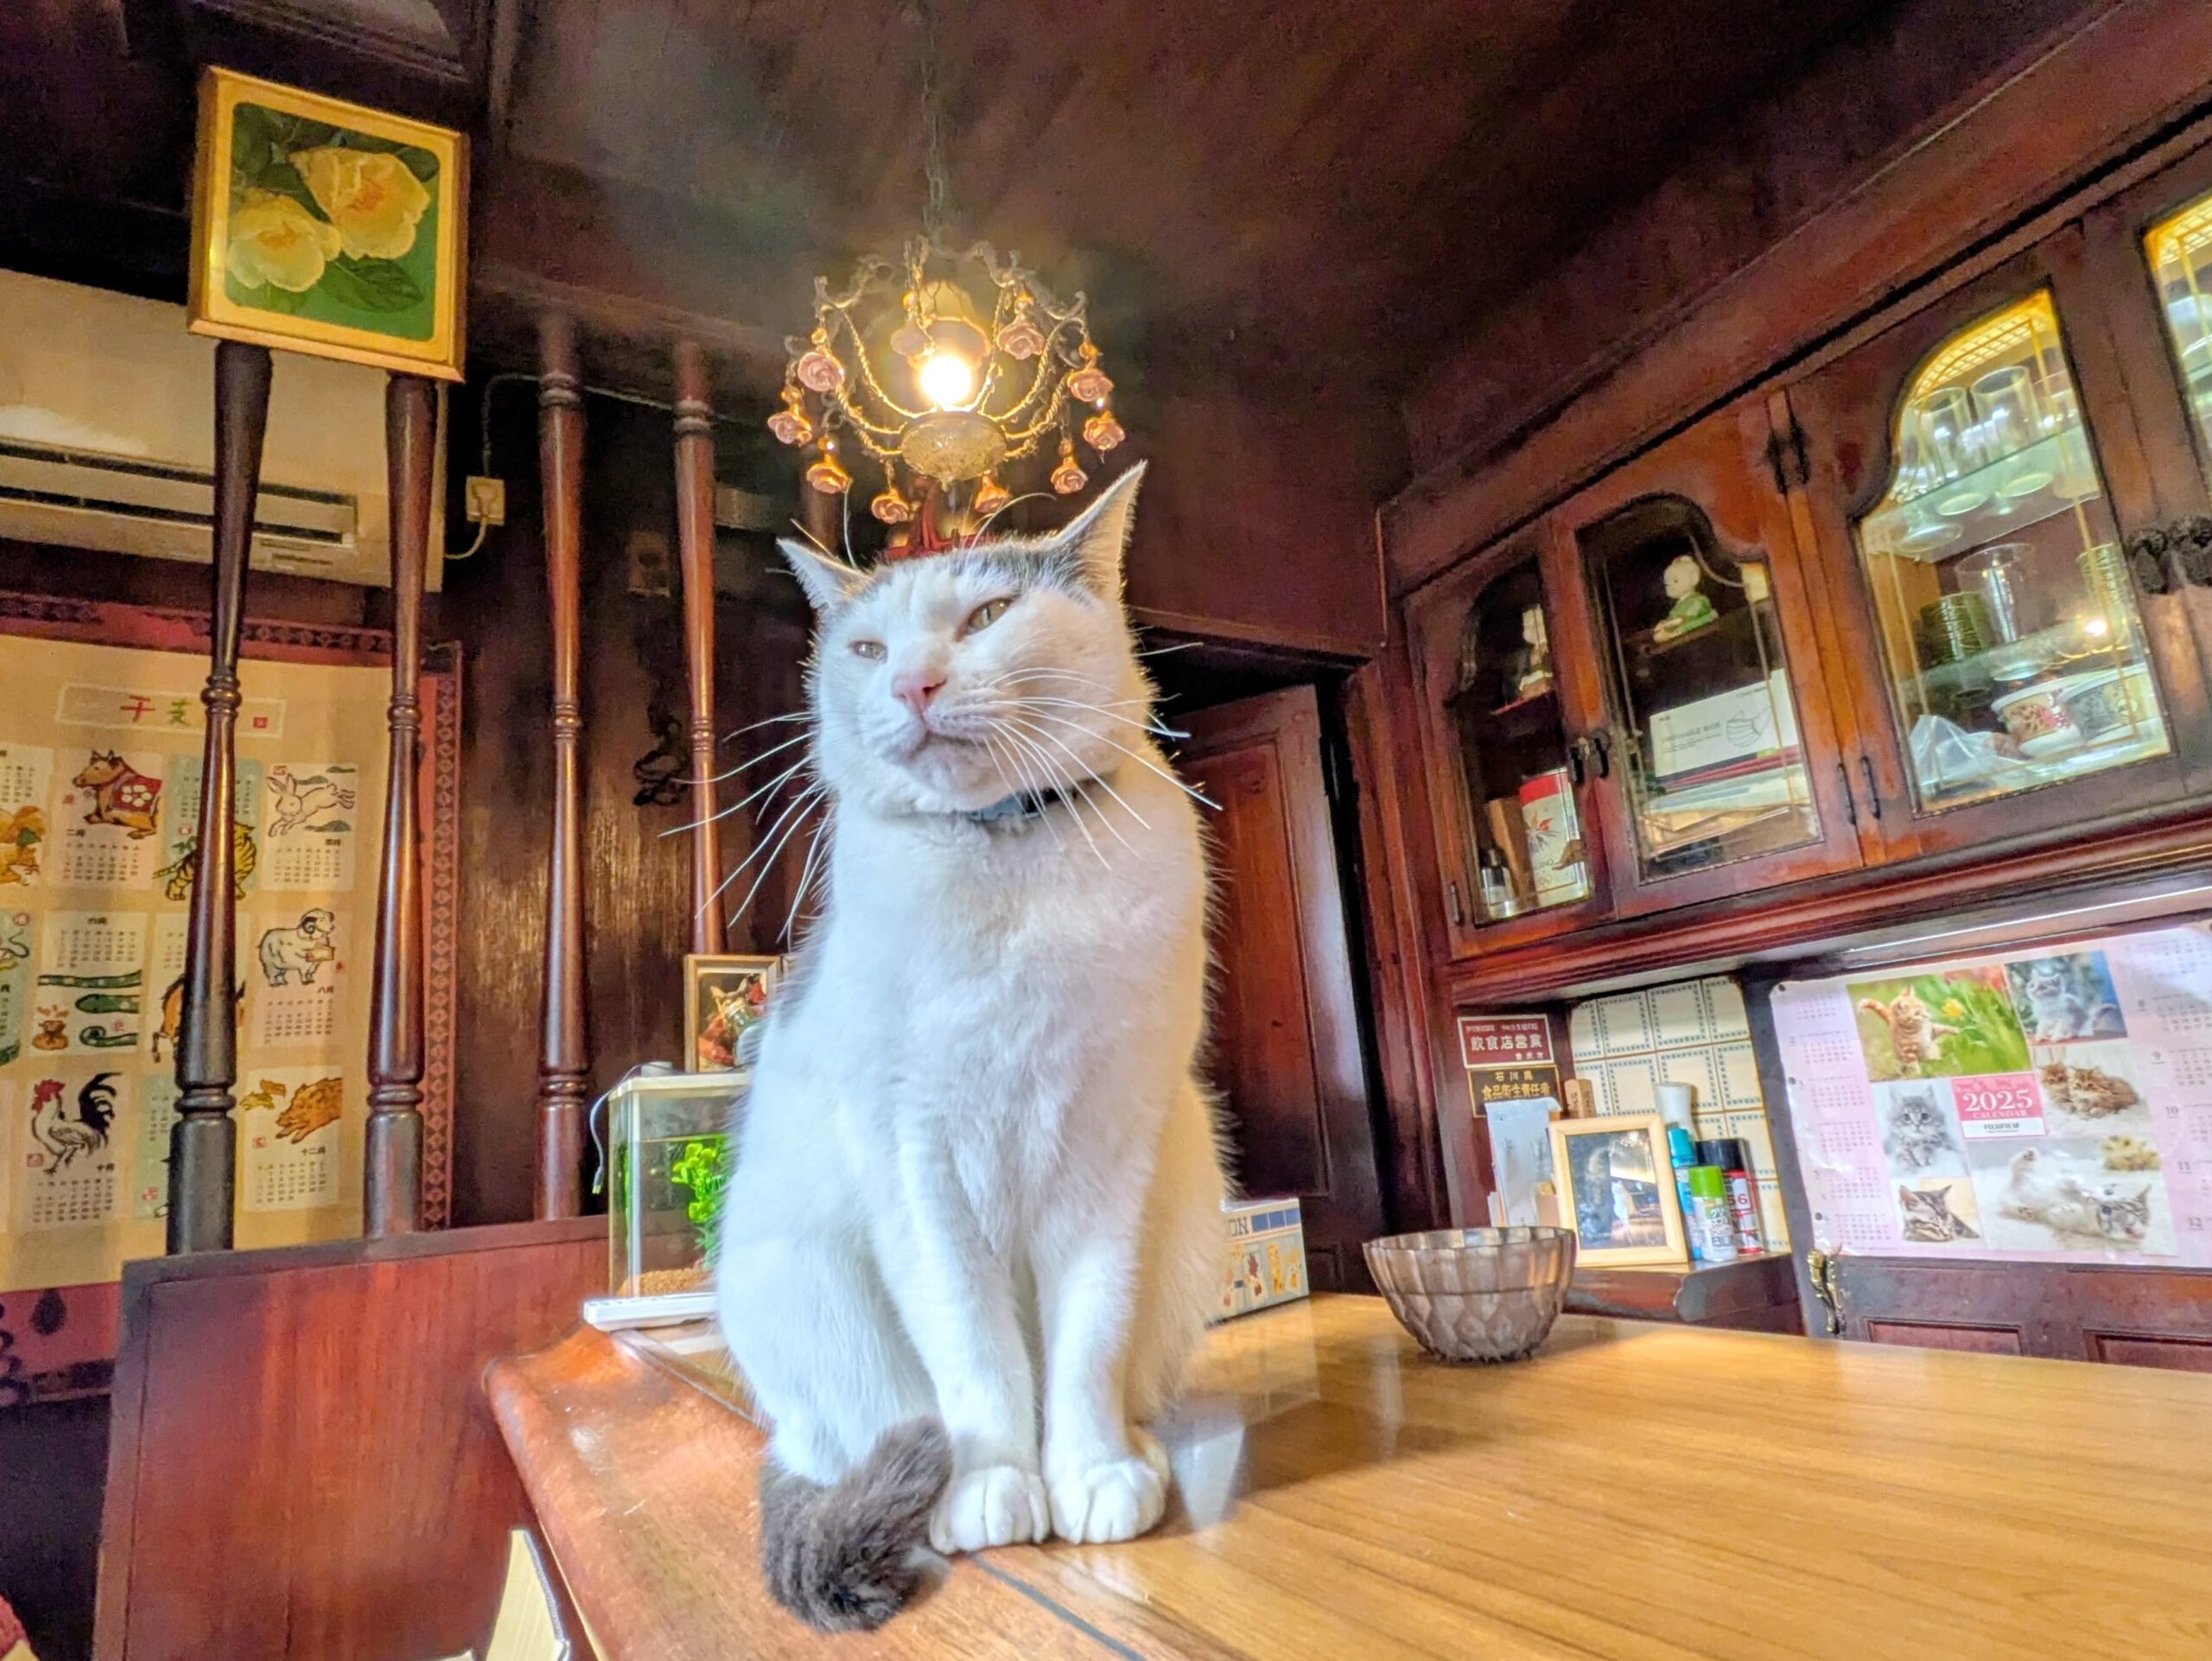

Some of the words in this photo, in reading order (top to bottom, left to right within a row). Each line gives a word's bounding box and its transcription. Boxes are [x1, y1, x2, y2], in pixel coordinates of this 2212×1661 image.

[1471, 1034, 1542, 1052] 飲食店営業
[1482, 1082, 1550, 1101] 食品衛生責任者
[1962, 1089, 2033, 1112] 2025
[1973, 1109, 2028, 1119] CALENDAR
